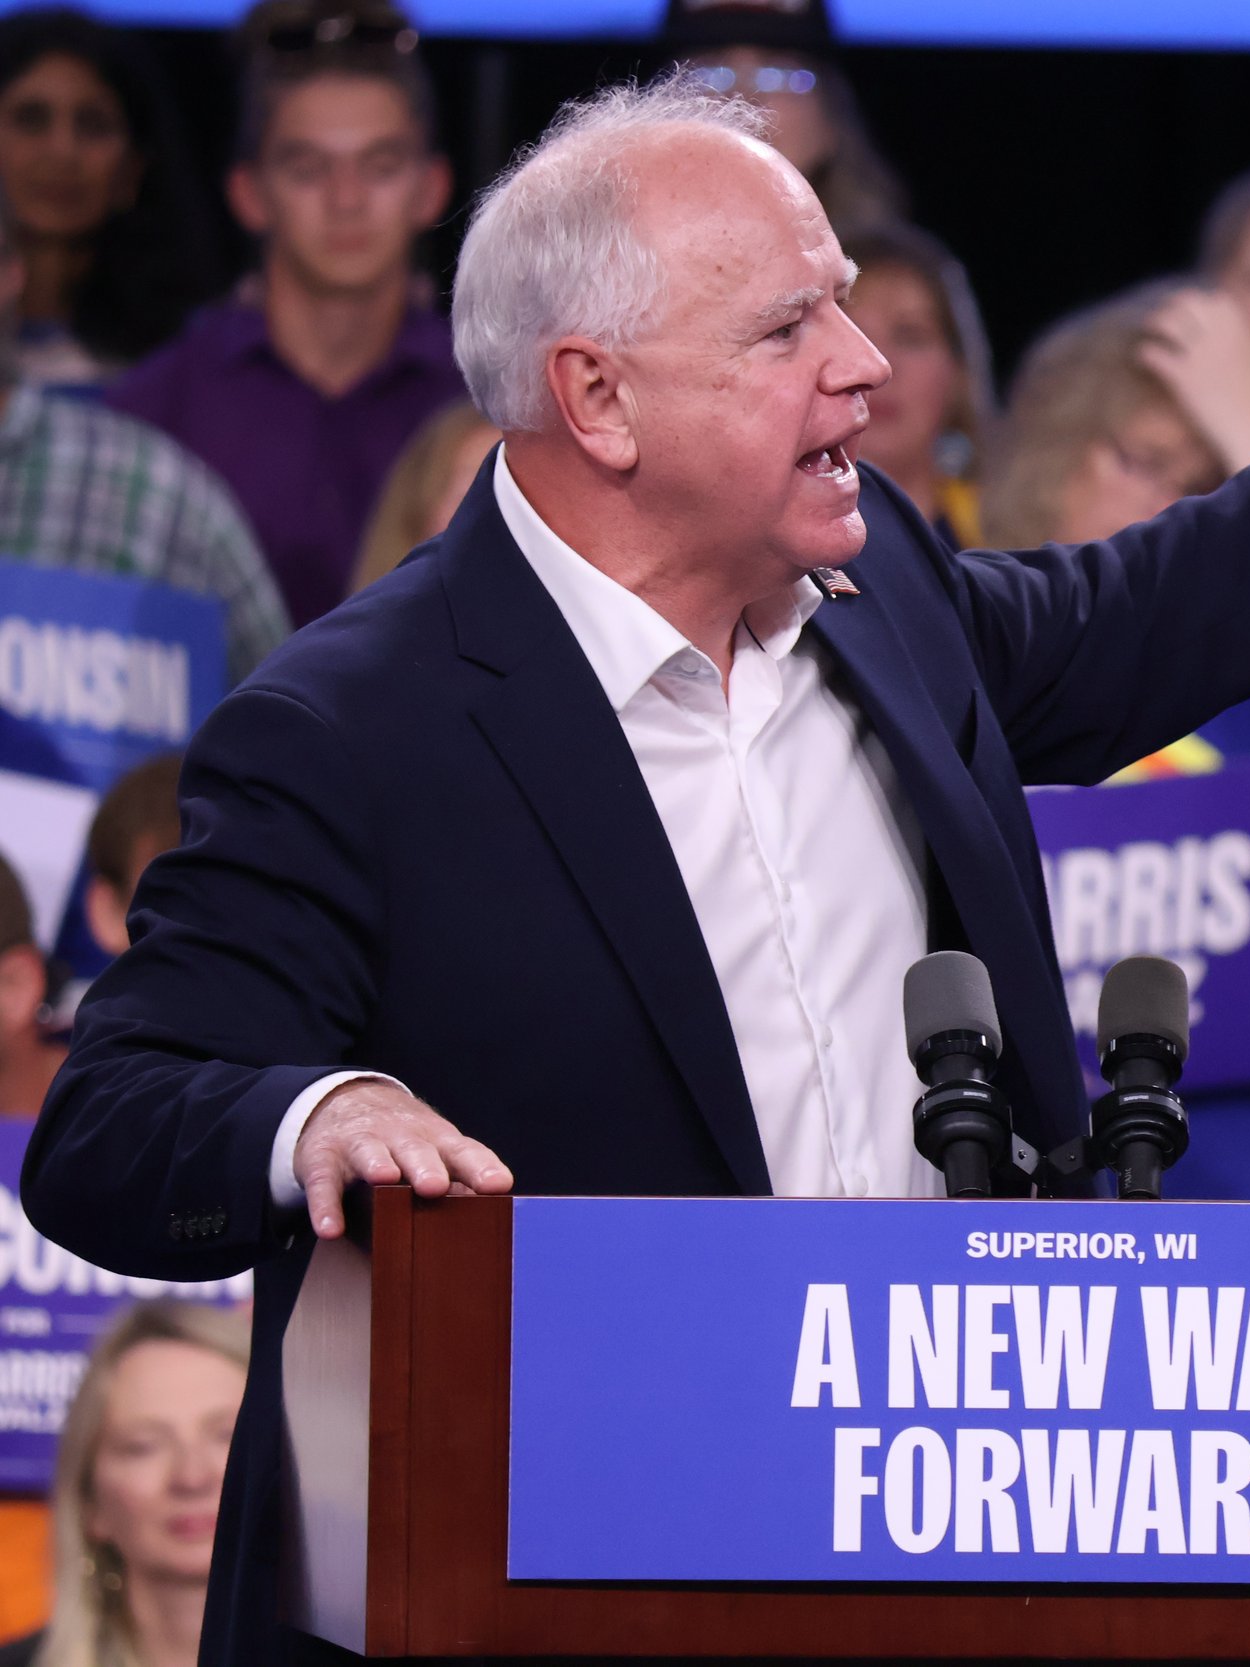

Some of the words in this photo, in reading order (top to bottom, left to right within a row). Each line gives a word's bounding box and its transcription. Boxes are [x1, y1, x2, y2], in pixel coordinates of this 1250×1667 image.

[966, 1231, 1146, 1264] SUPERIOR,
[1154, 1233, 1197, 1260] WI
[790, 1283, 862, 1408] A
[888, 1284, 1117, 1410] NEW
